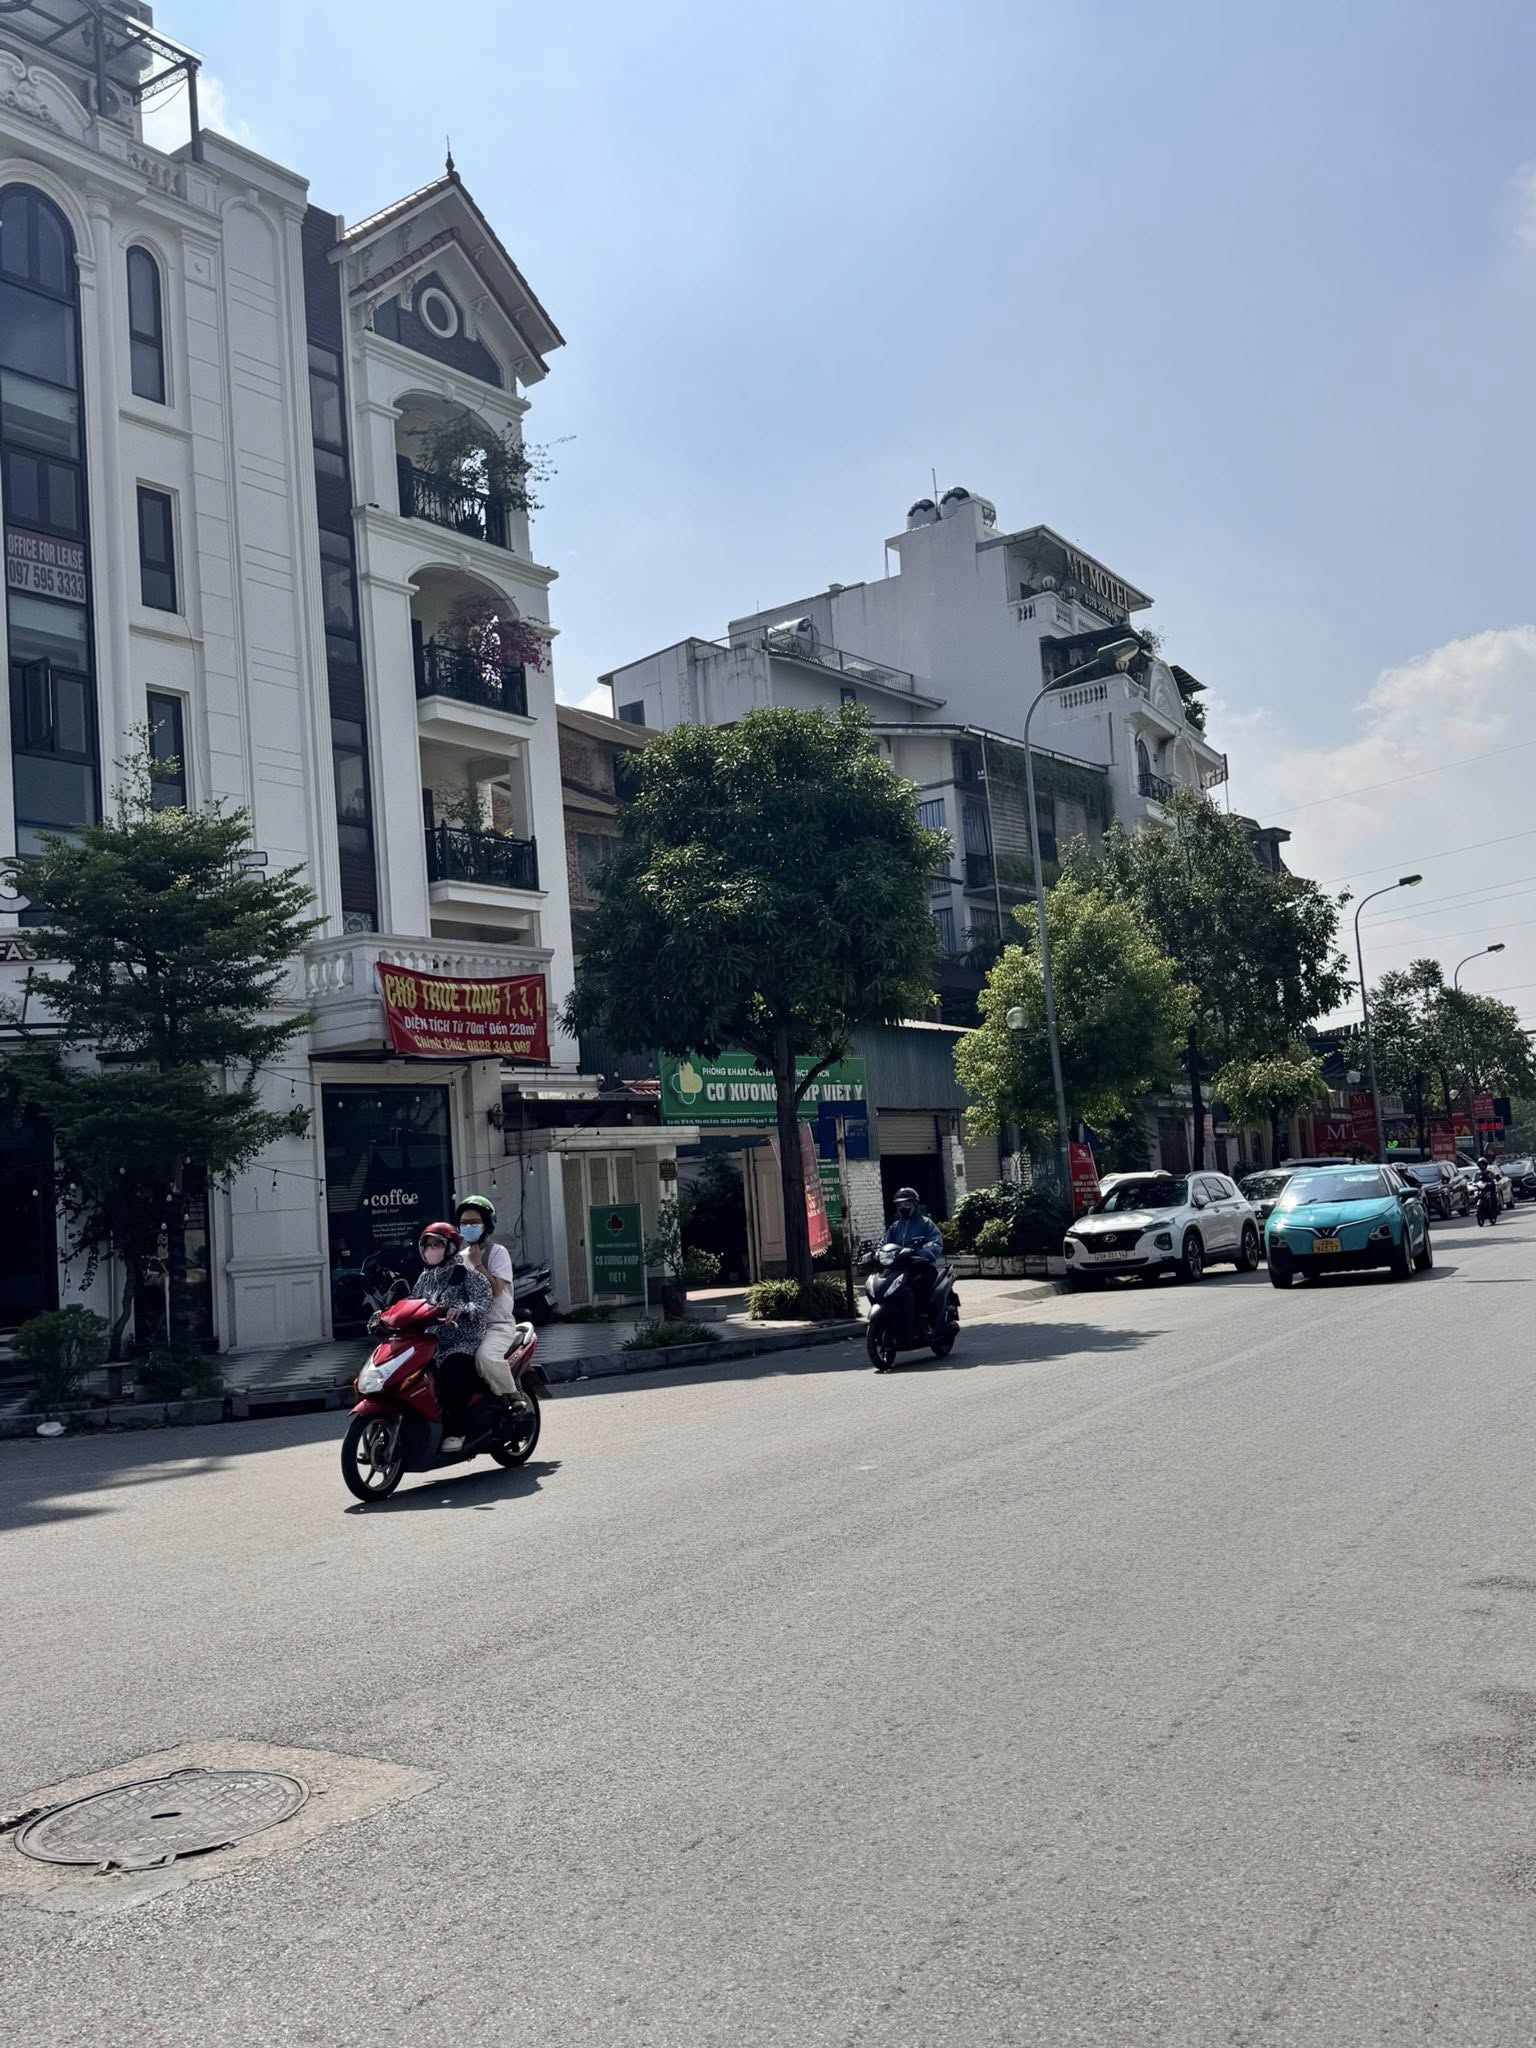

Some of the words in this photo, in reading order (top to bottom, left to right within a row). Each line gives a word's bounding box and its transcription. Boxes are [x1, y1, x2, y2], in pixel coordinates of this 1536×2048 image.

[7, 533, 38, 559] OFFICE
[38, 541, 56, 564] FOR
[57, 545, 84, 570] LEASE
[9, 560, 30, 586] 097
[33, 566, 54, 592] 595
[57, 571, 85, 599] 3333
[1087, 563, 1130, 612] MOTEL
[384, 973, 418, 1010] CHO
[536, 986, 544, 1018] 4
[428, 1016, 450, 1032] TÍCH
[702, 1064, 727, 1076] PHÒNG
[727, 1065, 747, 1076] KHÁM
[706, 1082, 726, 1102] CƠ
[729, 1082, 778, 1102] XƯƠNG
[370, 1187, 420, 1207] coffee
